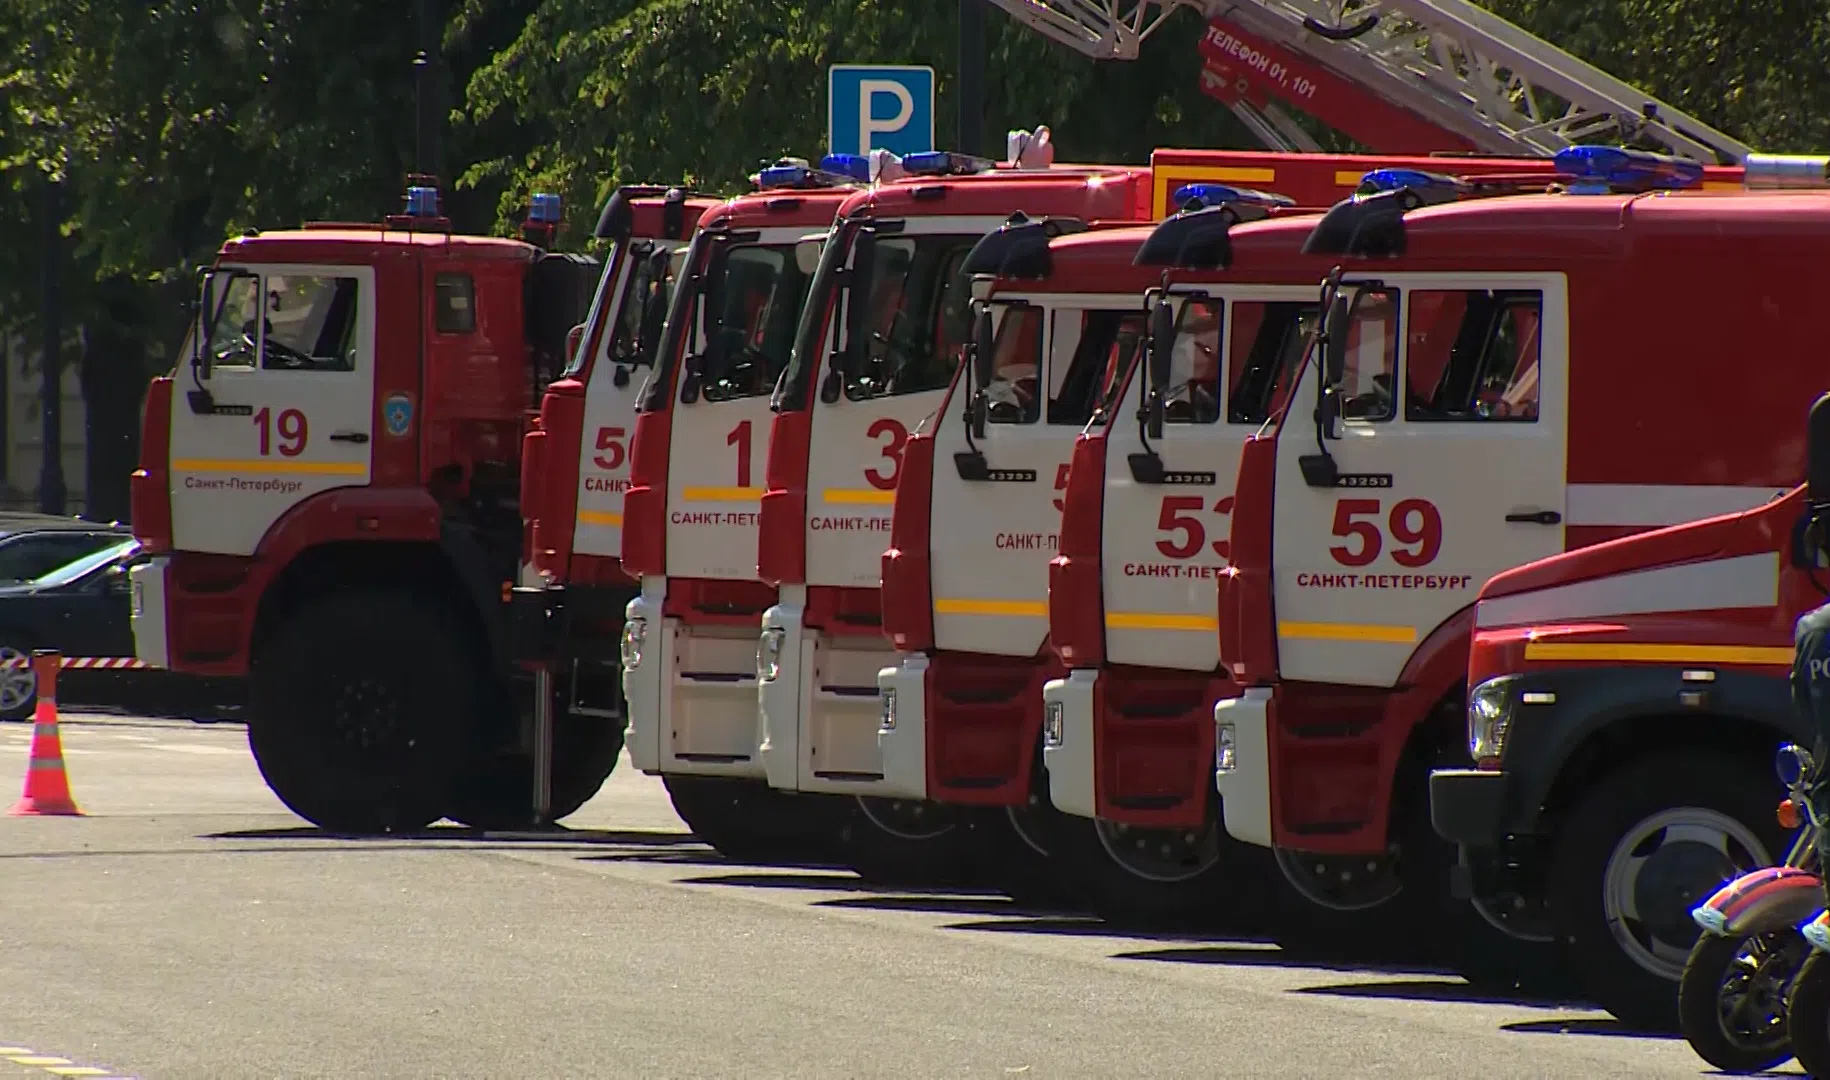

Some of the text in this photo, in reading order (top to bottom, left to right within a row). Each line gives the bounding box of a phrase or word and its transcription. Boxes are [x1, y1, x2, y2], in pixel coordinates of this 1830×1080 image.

[1206, 25, 1270, 72] ТЕЛЕФОН
[1293, 76, 1316, 99] 101
[860, 79, 914, 157] P
[253, 407, 308, 457] 19
[593, 427, 635, 470] 5
[727, 420, 752, 488] 1
[864, 419, 908, 490] 3
[185, 477, 302, 494] Санкт-Петербург
[671, 512, 761, 526] САНКТ-ПЕТ
[995, 533, 1062, 550] САНКТ-П
[1329, 499, 1442, 568] 59
[1296, 573, 1472, 589] САНКТ-ПЕТЕРБУРГ
